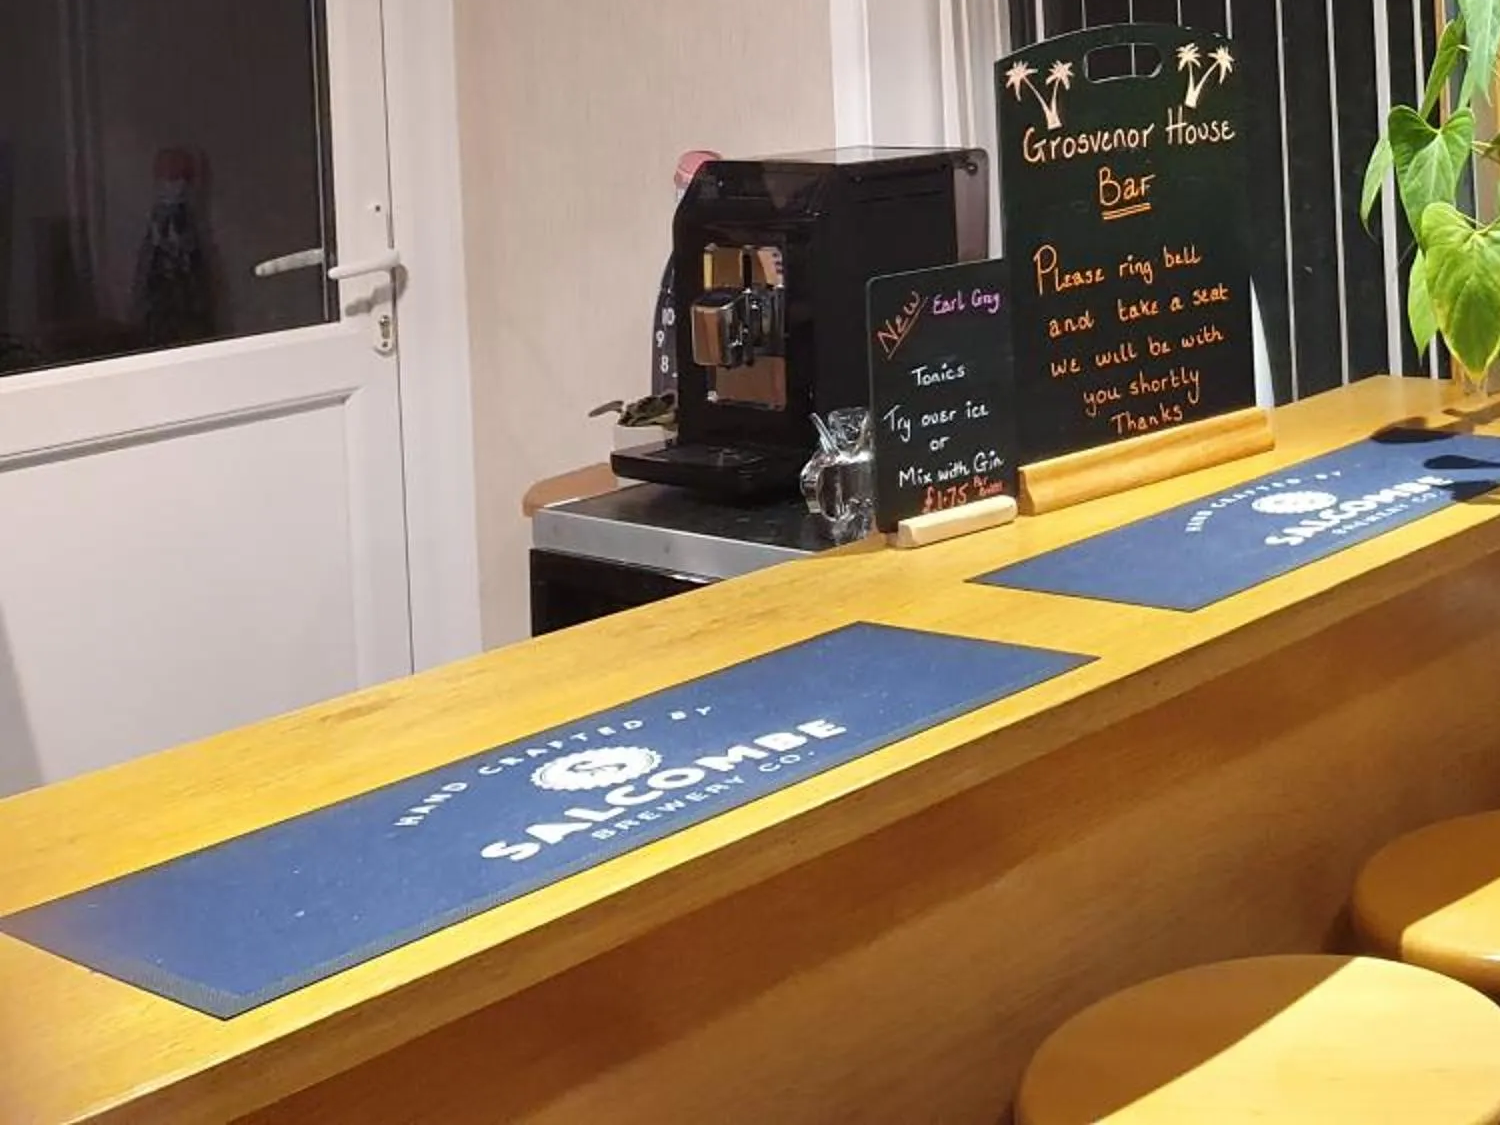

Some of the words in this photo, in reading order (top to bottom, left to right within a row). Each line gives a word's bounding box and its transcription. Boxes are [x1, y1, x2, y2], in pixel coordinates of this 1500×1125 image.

[1022, 121, 1154, 163] Grosvenor
[1165, 107, 1236, 146] House
[1098, 166, 1157, 207] Bar
[1033, 244, 1105, 295] Please
[1118, 255, 1153, 284] ring
[1162, 245, 1203, 268] bell
[877, 291, 921, 354] New
[933, 289, 965, 315] Earl
[1049, 315, 1096, 340] and
[1117, 297, 1160, 322] take
[1169, 296, 1184, 313] a
[1192, 283, 1231, 305] seat
[656, 330, 664, 347] 9
[1050, 357, 1081, 378] we
[1095, 342, 1137, 367] will
[1148, 335, 1172, 357] be
[1180, 328, 1225, 352] with
[661, 355, 669, 373] 8
[911, 362, 966, 387] Tonics
[1083, 385, 1121, 417] you
[1128, 368, 1201, 405] shortly
[883, 405, 912, 442] Try
[921, 409, 957, 425] over
[966, 400, 990, 420] ice
[1110, 405, 1184, 435] Thanks
[929, 436, 950, 452] or
[899, 467, 933, 488] Mix
[937, 461, 970, 482] with
[973, 451, 1005, 473] Gin
[394, 782, 468, 827] HAND
[477, 719, 643, 776] CRAFTED
[668, 705, 712, 720] BY
[480, 718, 847, 861] SALCOMBE
[591, 774, 745, 840] BREWERY
[758, 749, 816, 773] CO.
